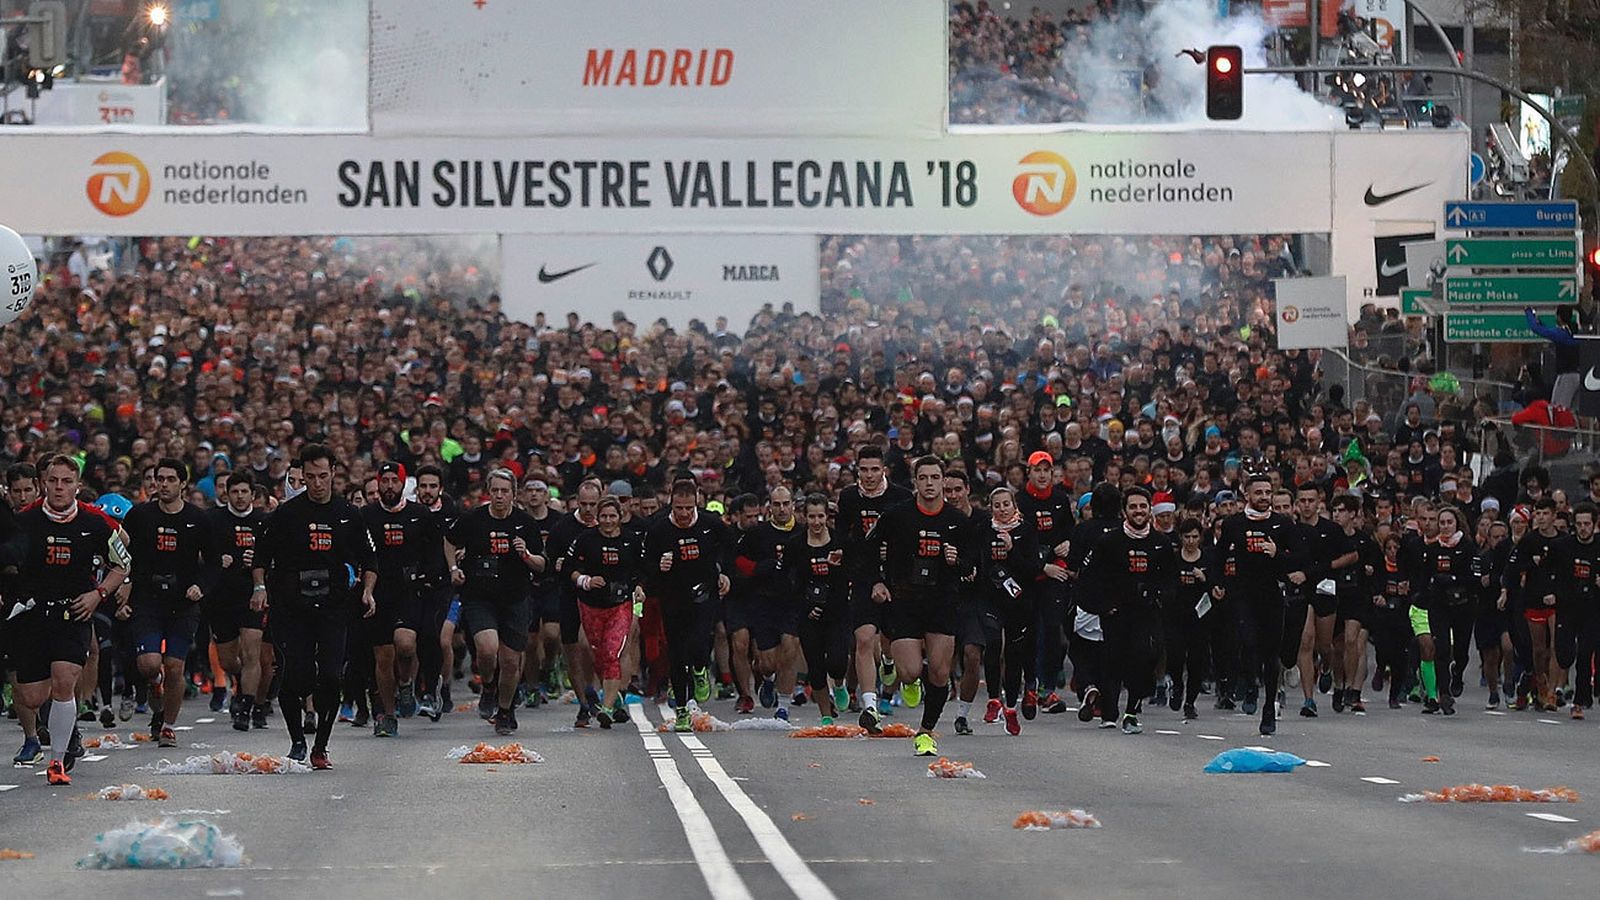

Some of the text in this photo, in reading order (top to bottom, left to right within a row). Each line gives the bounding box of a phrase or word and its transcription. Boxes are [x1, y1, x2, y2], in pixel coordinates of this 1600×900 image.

[582, 48, 734, 87] MADRID
[164, 160, 270, 180] nationale
[1090, 158, 1196, 178] nationale
[338, 160, 419, 208] SAN
[433, 160, 650, 208] SILVESTRE
[664, 160, 912, 208] VALLECANA
[1090, 183, 1233, 203] nederlanden
[164, 184, 307, 204] nederlanden
[1536, 210, 1574, 222] Burgos
[1549, 249, 1574, 258] Lima
[722, 265, 780, 281] MARCA
[628, 291, 692, 300] RENAULT
[1448, 291, 1482, 300] Madre
[1448, 326, 1538, 337] Presidente Cárde
[309, 532, 332, 551] 31D
[919, 538, 941, 556] 31D
[46, 545, 72, 566] 31D
